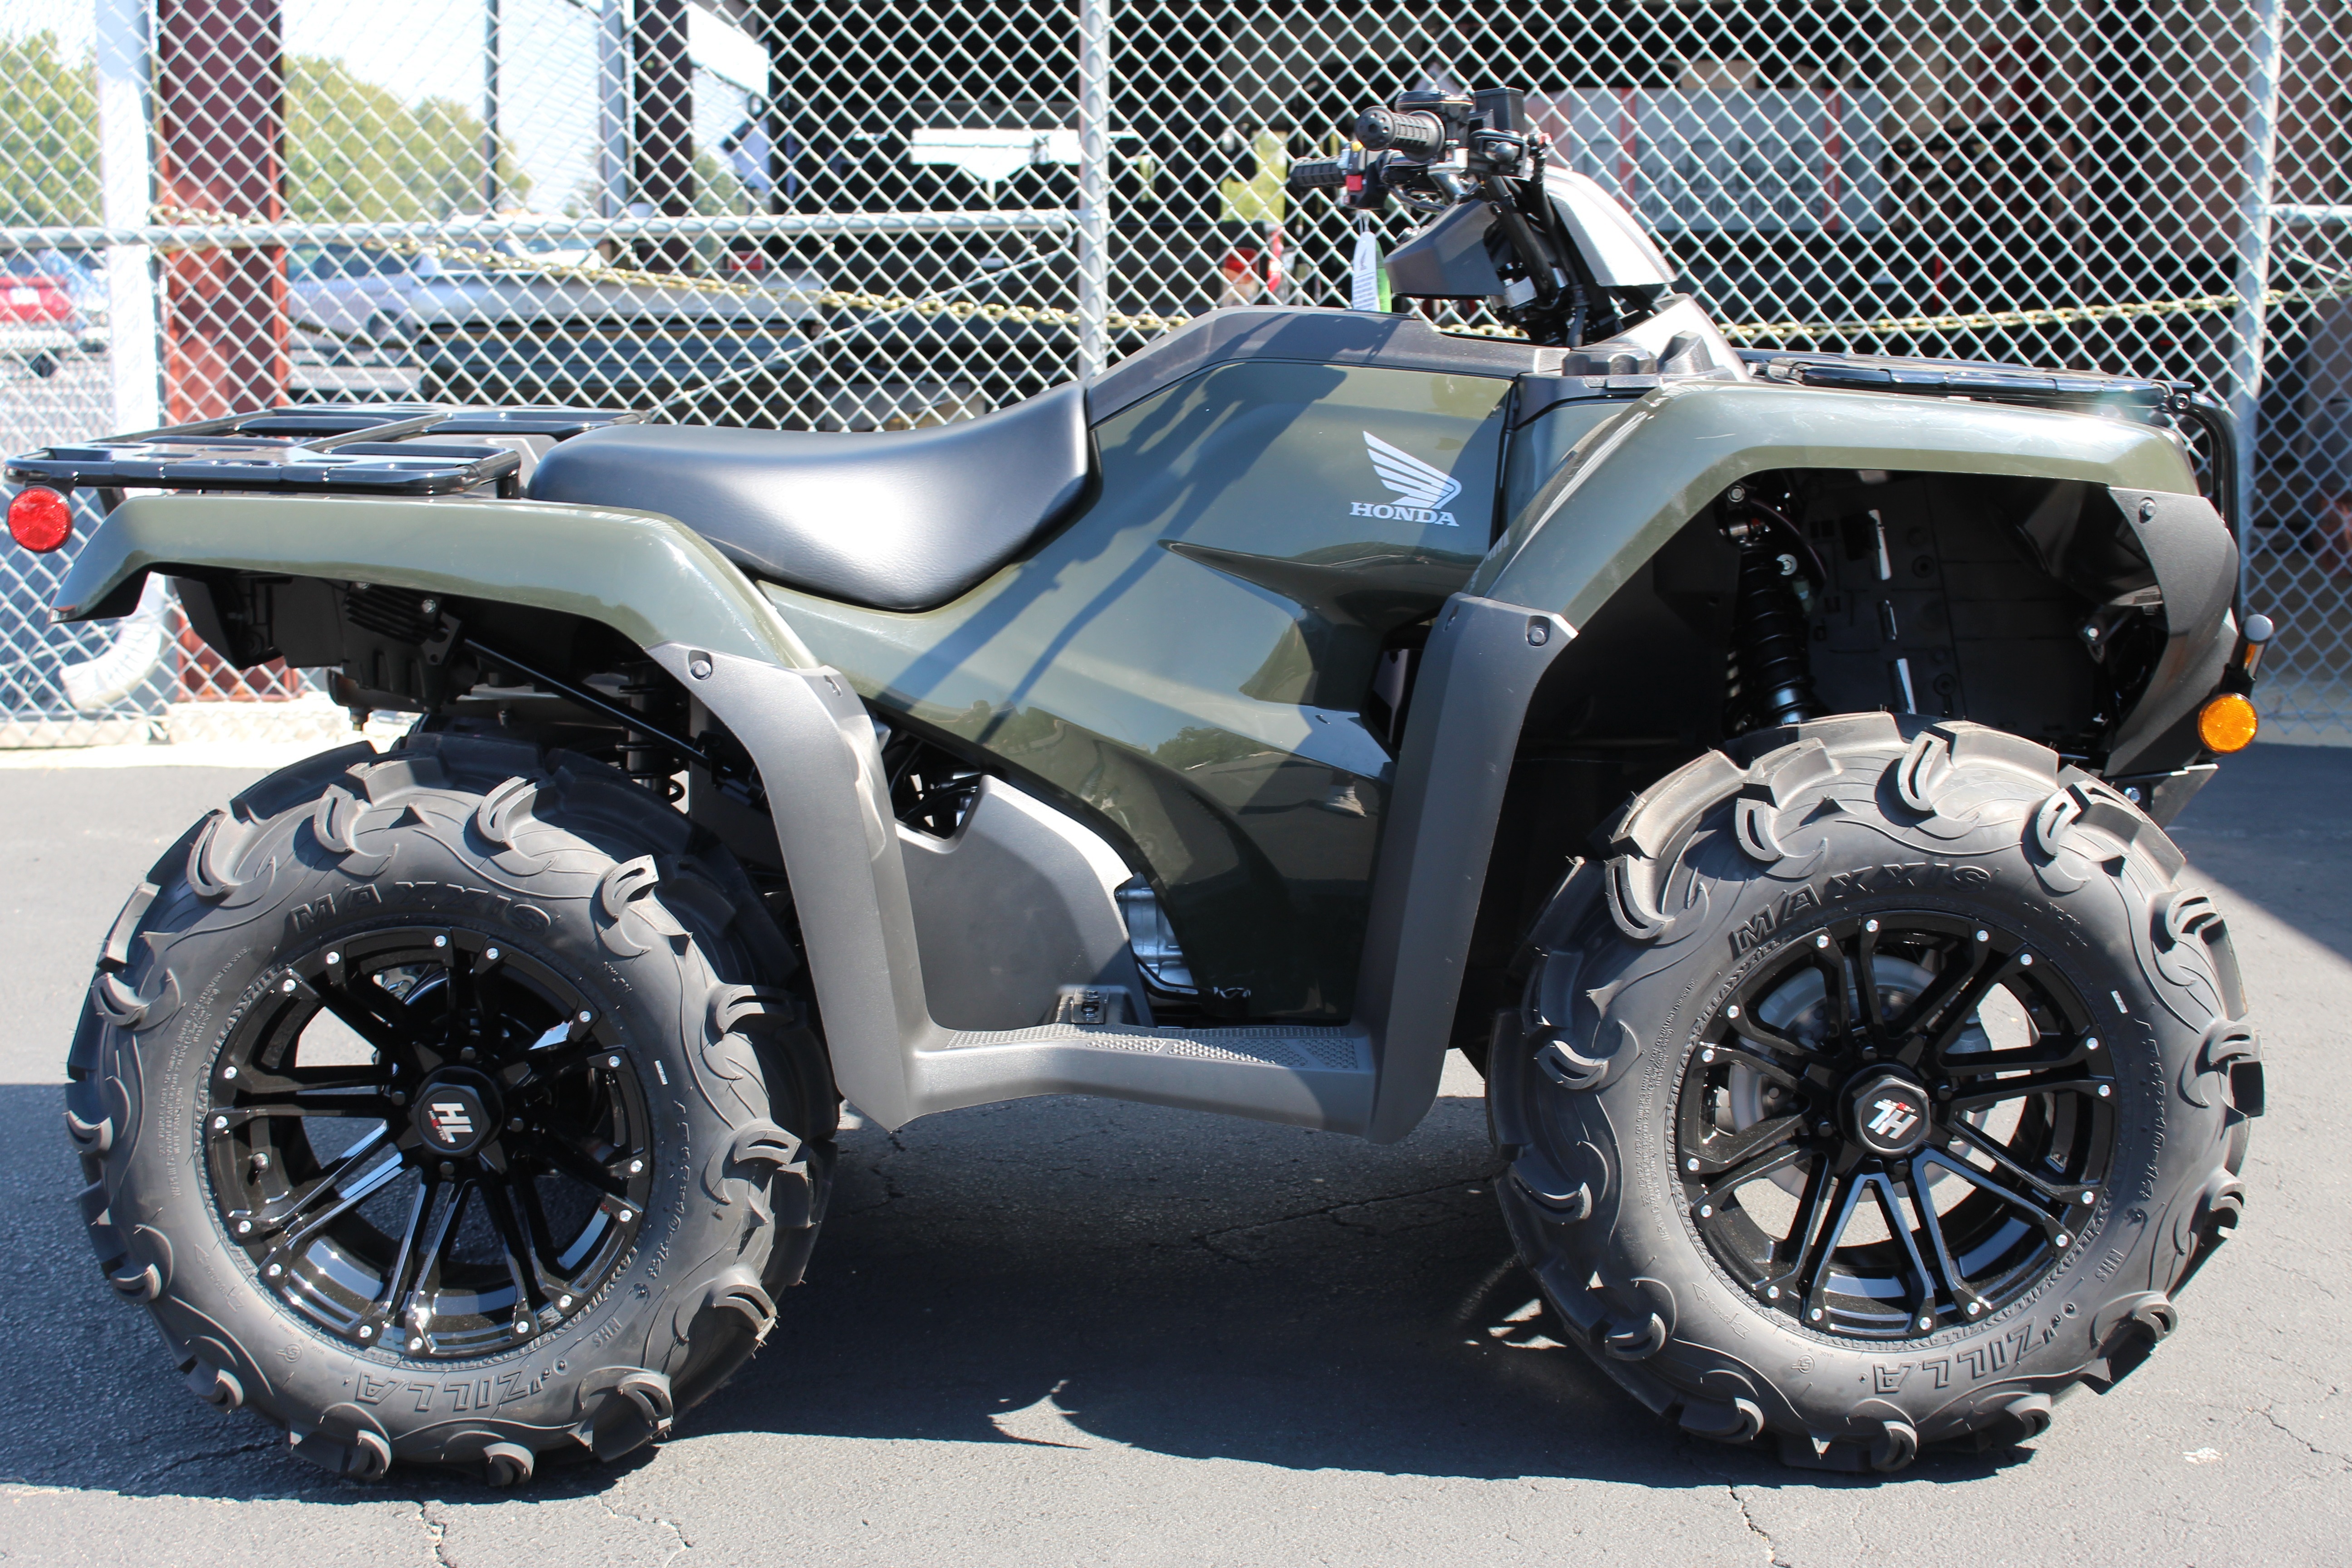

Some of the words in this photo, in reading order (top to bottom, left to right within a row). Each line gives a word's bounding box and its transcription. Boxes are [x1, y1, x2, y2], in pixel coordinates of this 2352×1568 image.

[1349, 502, 1459, 527] HONDA
[290, 881, 551, 933] MAXXIS
[1732, 861, 1991, 954] MAXXIS
[431, 1103, 474, 1143] HL
[1867, 1100, 1918, 1140] HL
[2096, 1248, 2124, 1283] NHS
[593, 1318, 622, 1349] NHS
